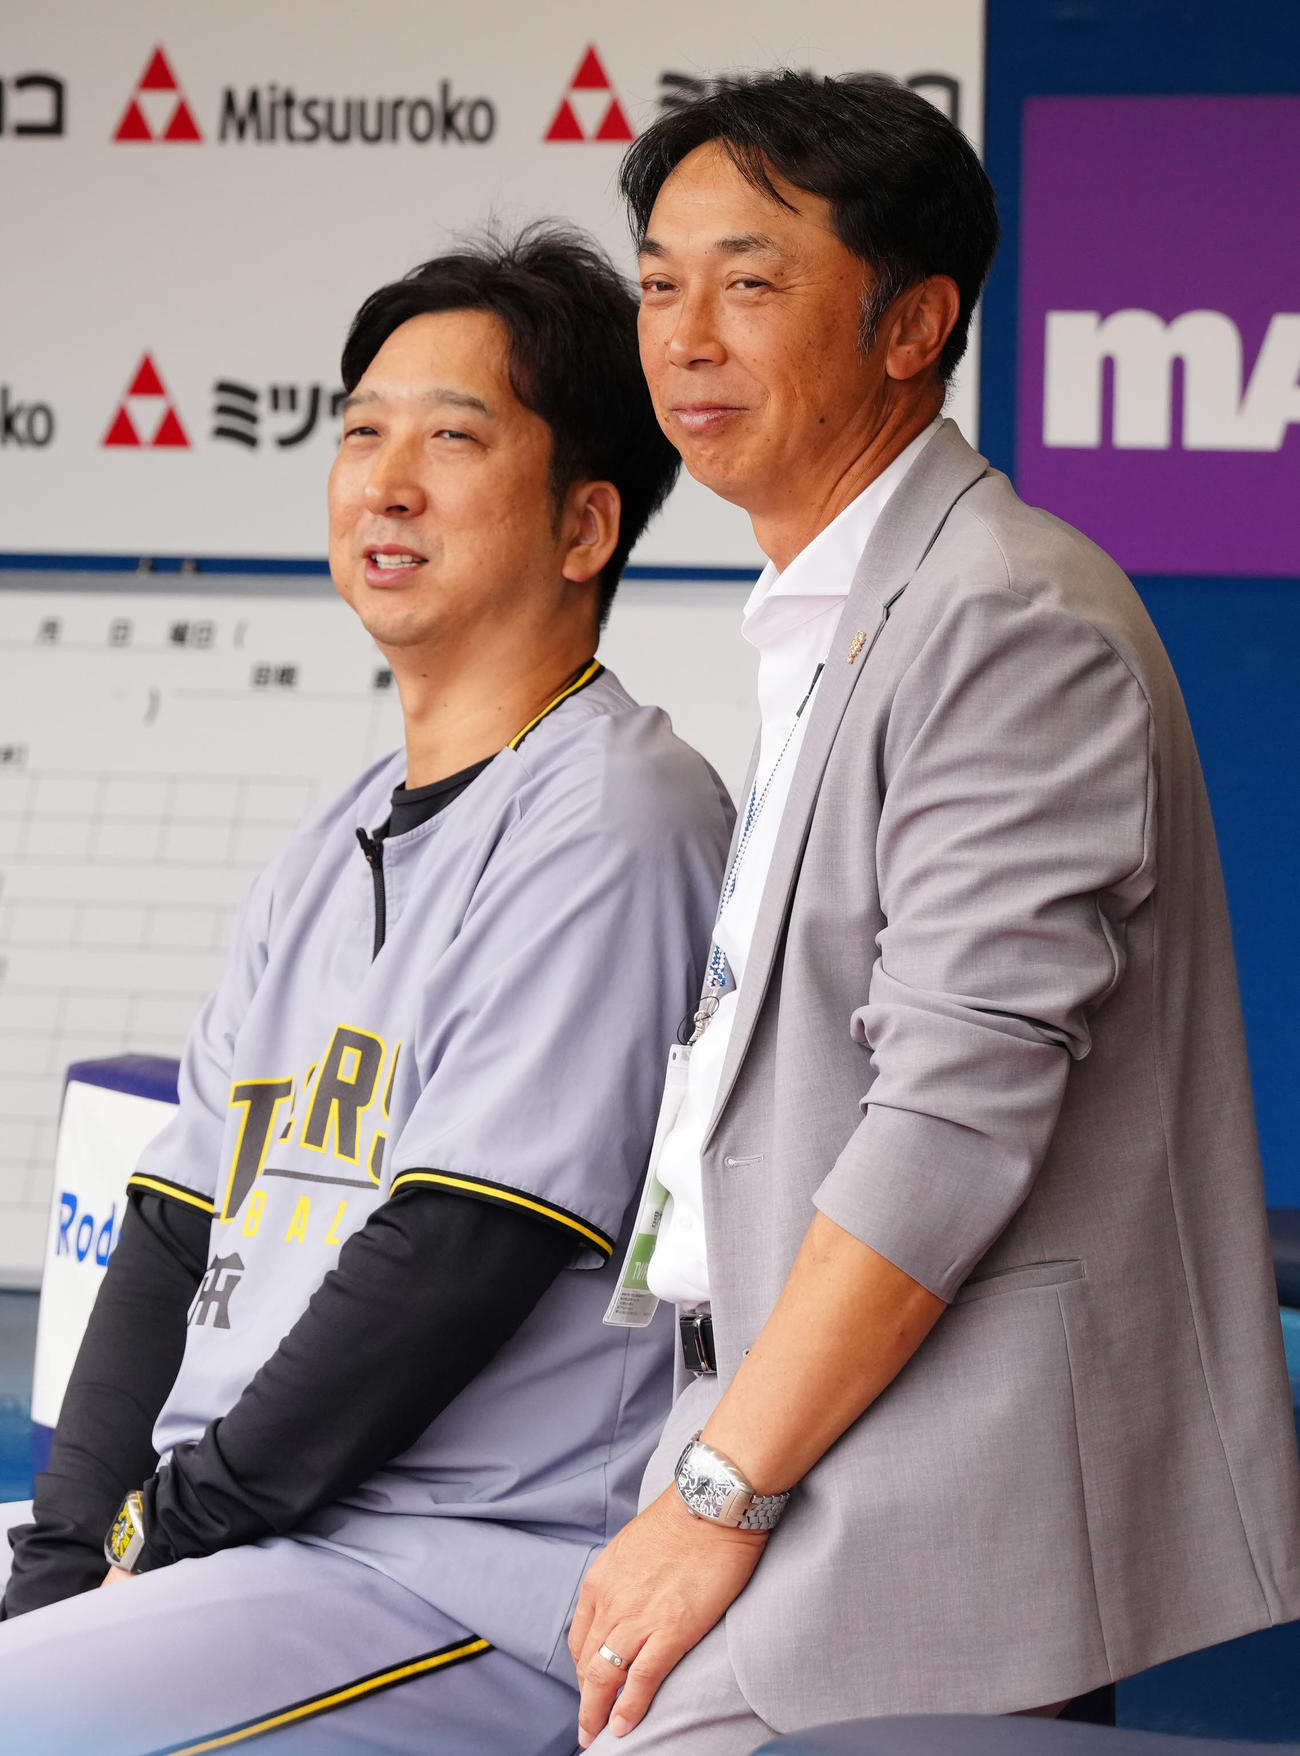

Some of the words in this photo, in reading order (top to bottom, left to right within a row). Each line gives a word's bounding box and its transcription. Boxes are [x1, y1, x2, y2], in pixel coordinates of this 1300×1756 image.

[0, 73, 65, 138] コ
[219, 79, 497, 145] Mitsuuroko
[213, 381, 350, 448] ミツ
[57, 1191, 123, 1267] Rod
